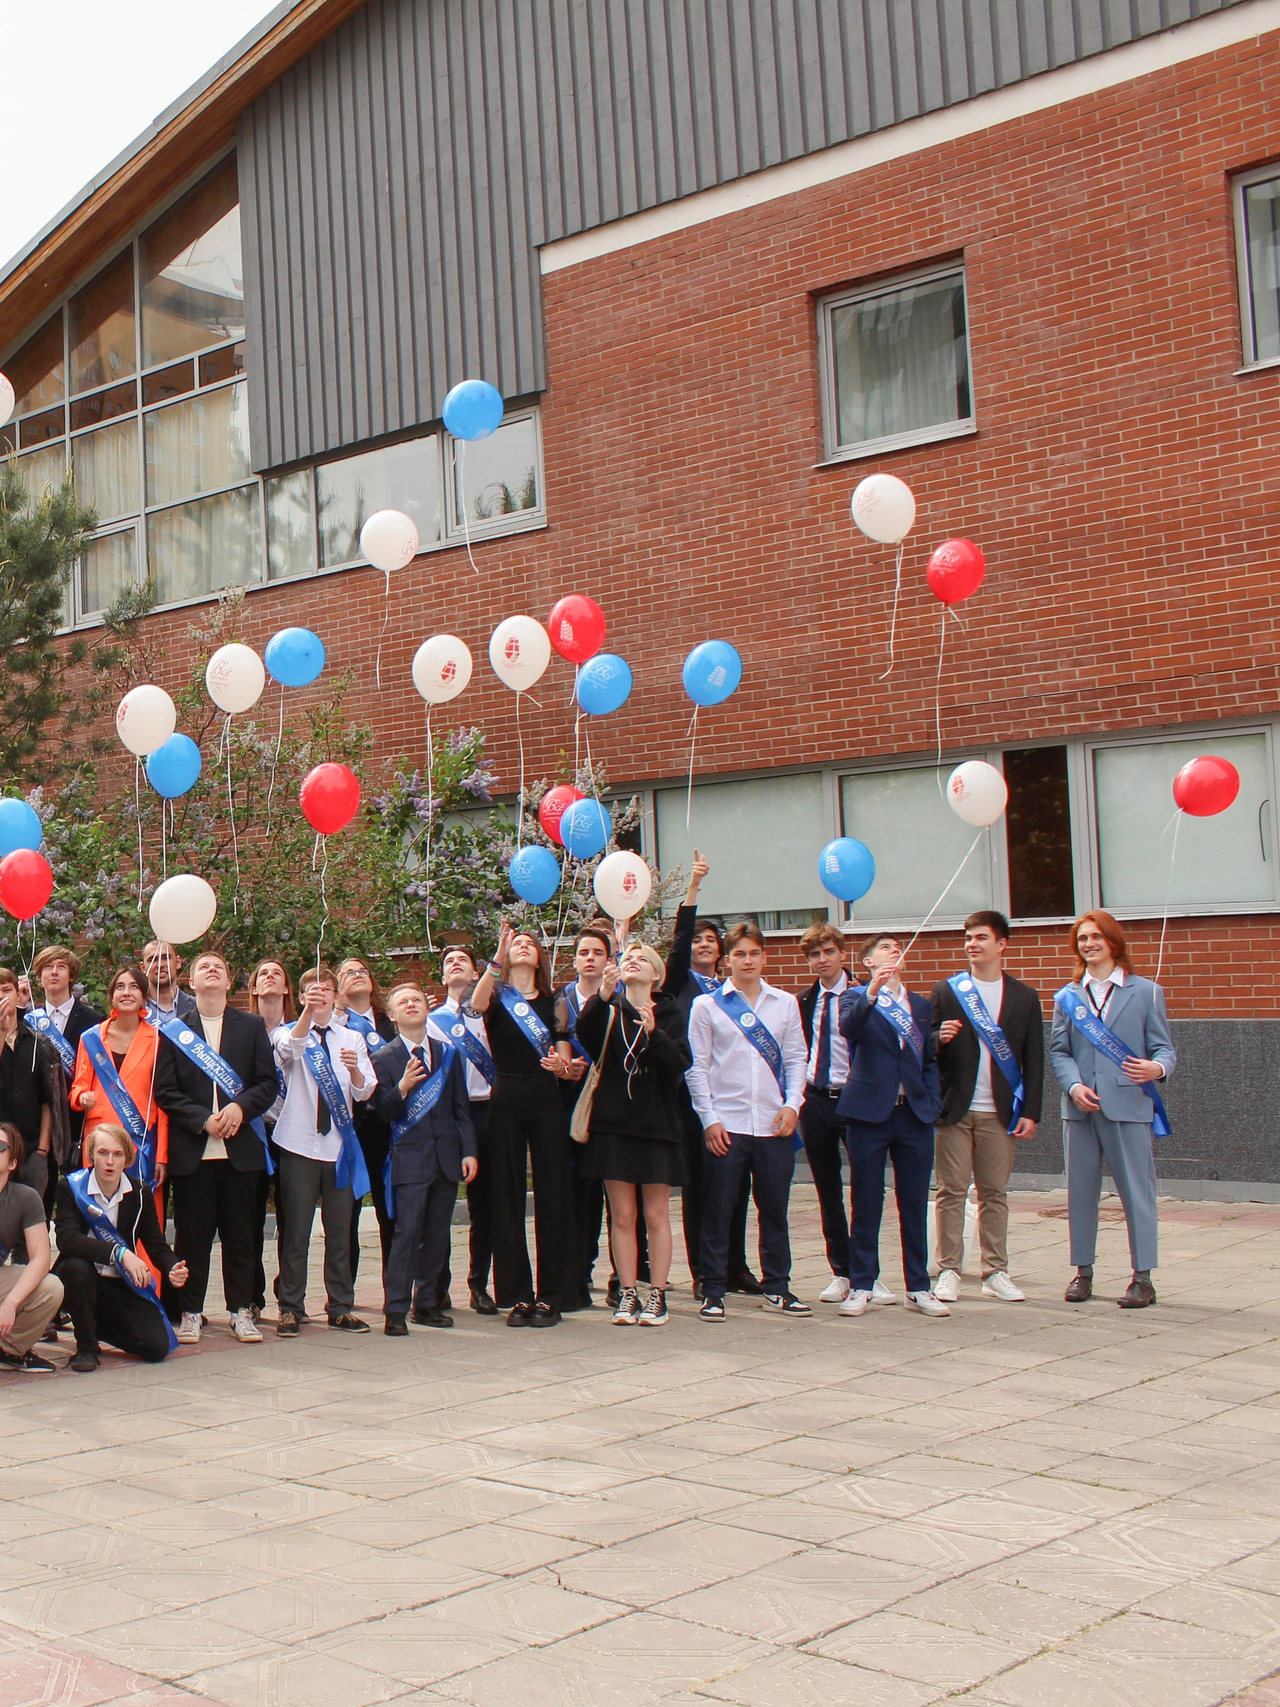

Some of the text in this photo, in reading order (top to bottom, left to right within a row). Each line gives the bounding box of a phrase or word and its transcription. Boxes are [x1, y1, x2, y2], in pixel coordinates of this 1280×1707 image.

[542, 798, 567, 813] Всё
[568, 814, 595, 829] Всё
[513, 862, 535, 877] Всё
[751, 1027, 780, 1067] Выпуск
[889, 1008, 922, 1052] Выпускни
[964, 993, 1013, 1061] Выпускник 2023
[190, 1042, 236, 1089] Выпускник
[310, 1050, 341, 1106] Выпускник
